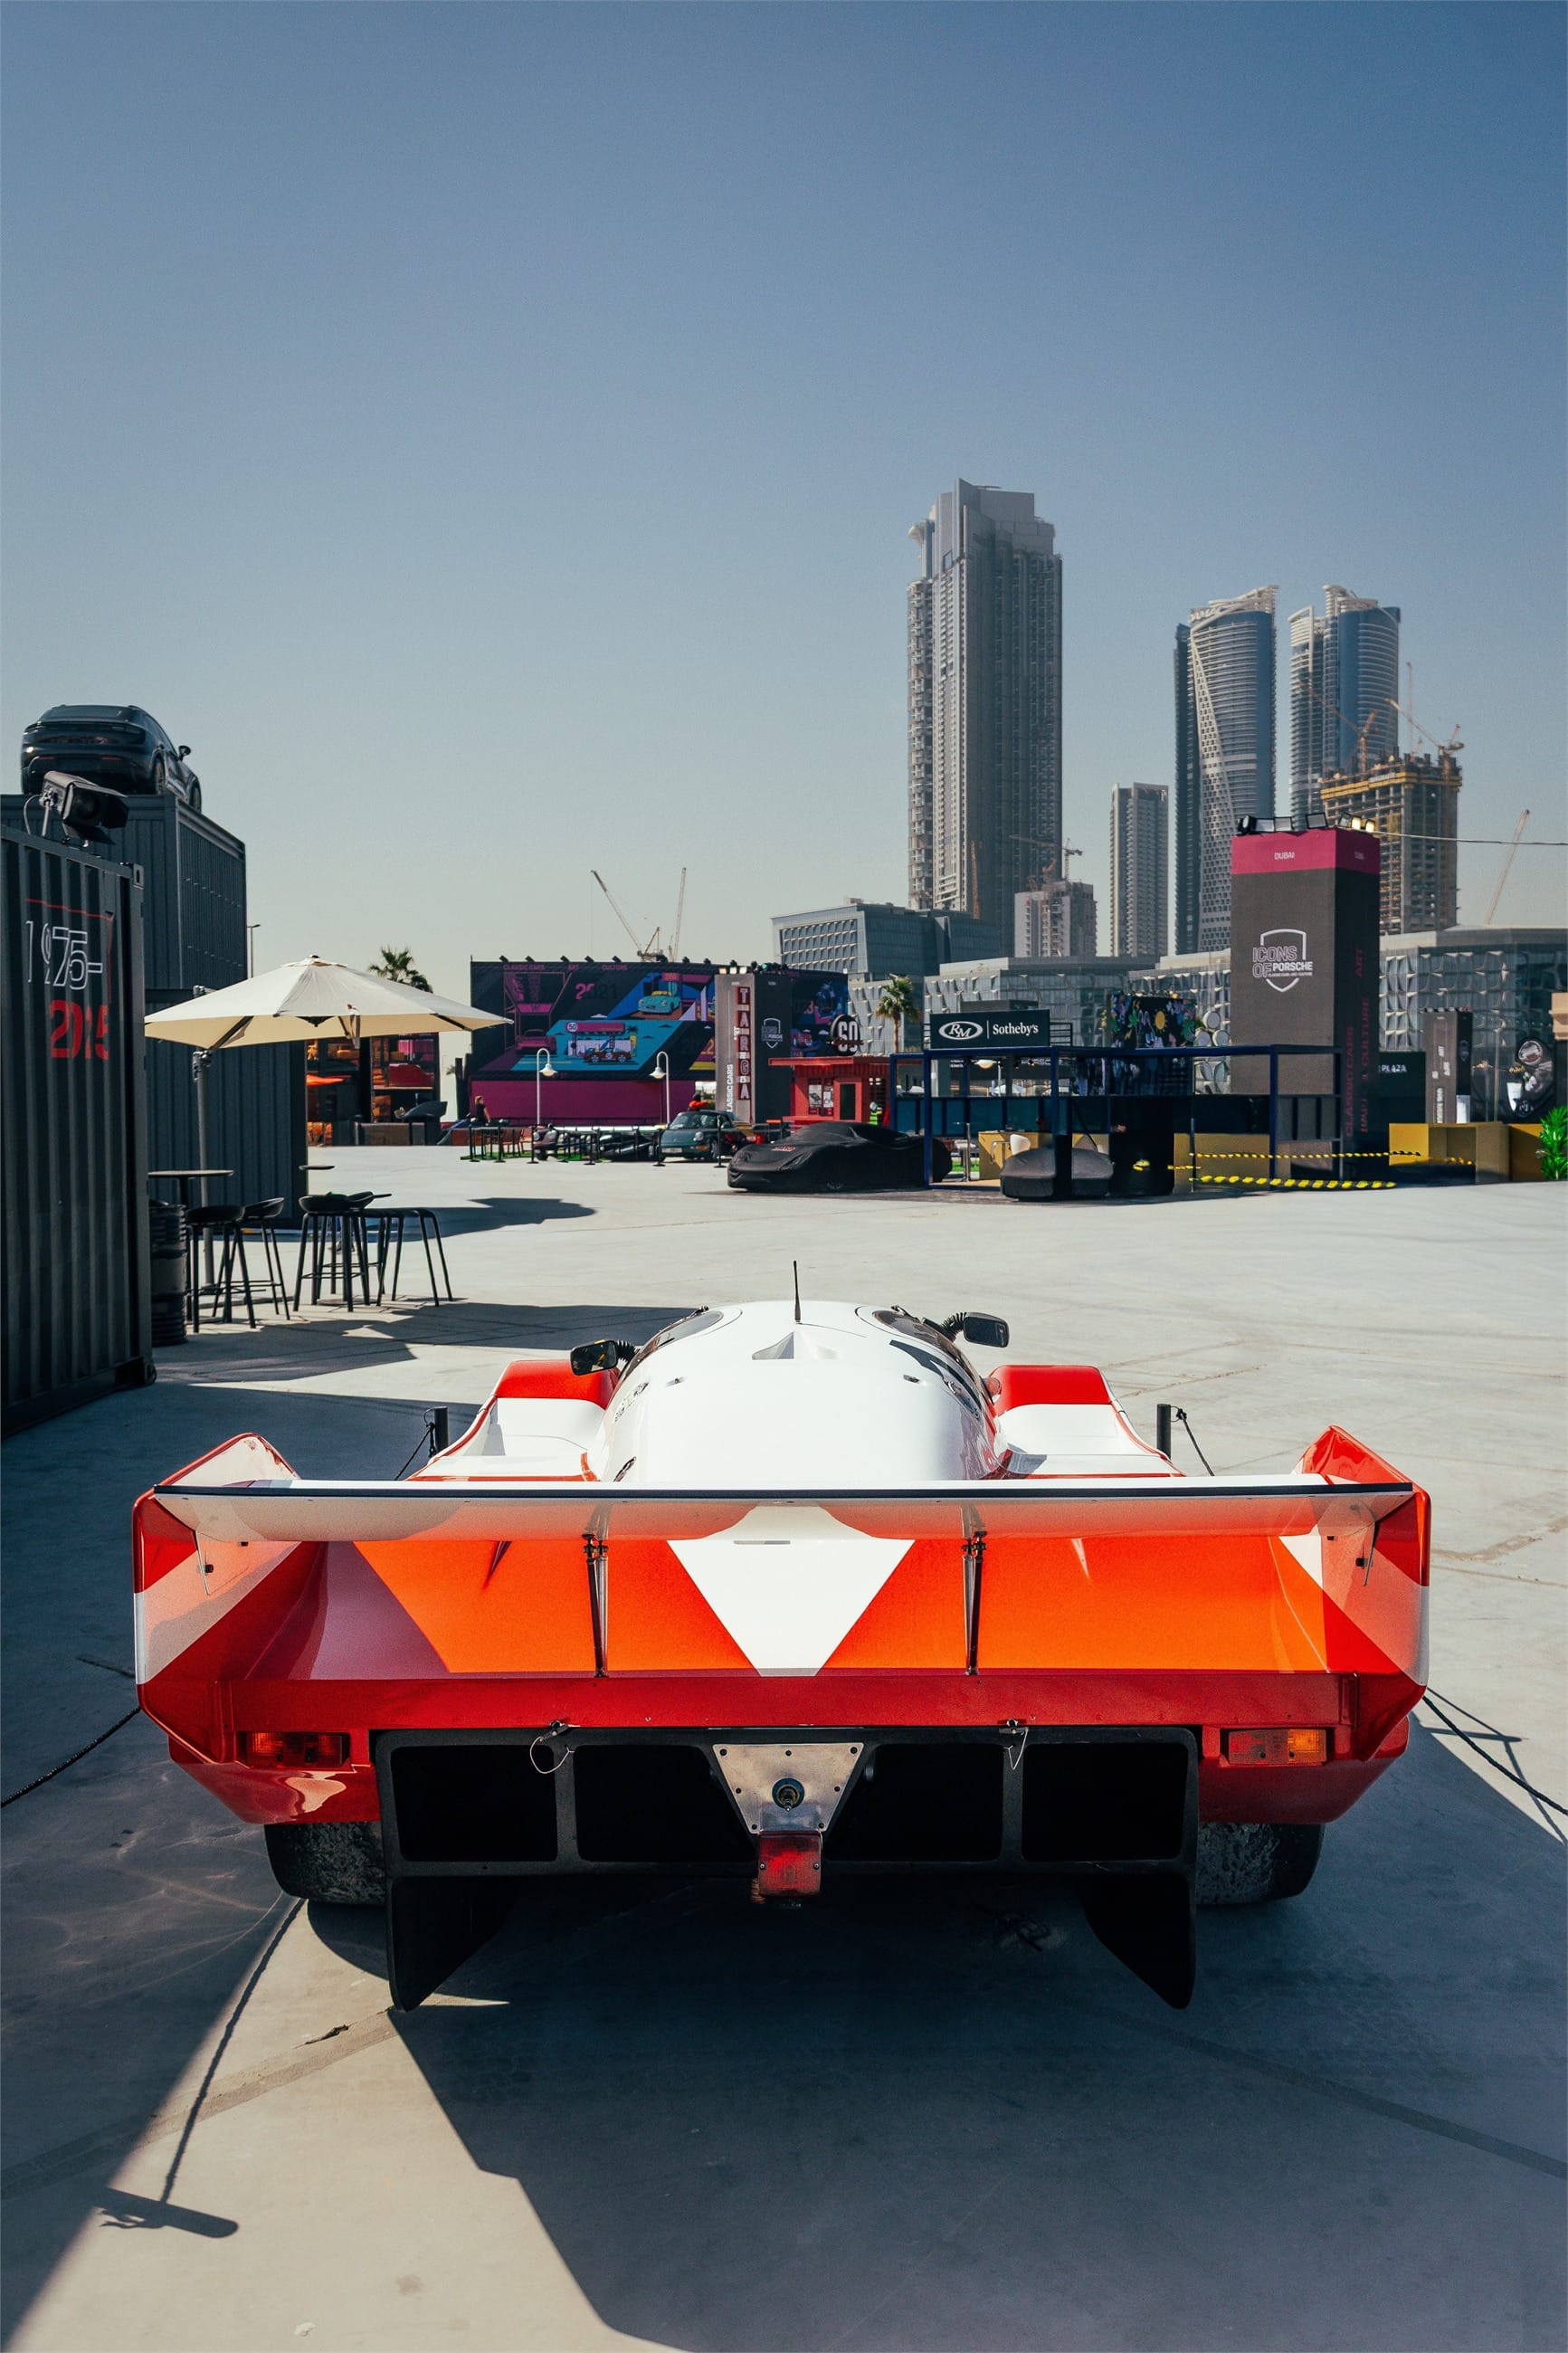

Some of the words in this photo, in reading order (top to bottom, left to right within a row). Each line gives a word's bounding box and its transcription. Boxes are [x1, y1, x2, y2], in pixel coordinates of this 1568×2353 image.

[1274, 852, 1295, 861] DUBAI
[1252, 946, 1297, 963] ICONS
[1252, 963, 1272, 978] OF
[1272, 961, 1314, 972] PORSCHE
[948, 1024, 971, 1038] RM
[993, 1022, 1039, 1036] Sotheby's
[739, 987, 750, 1100] TARGA
[1381, 1064, 1407, 1072] PLAZA
